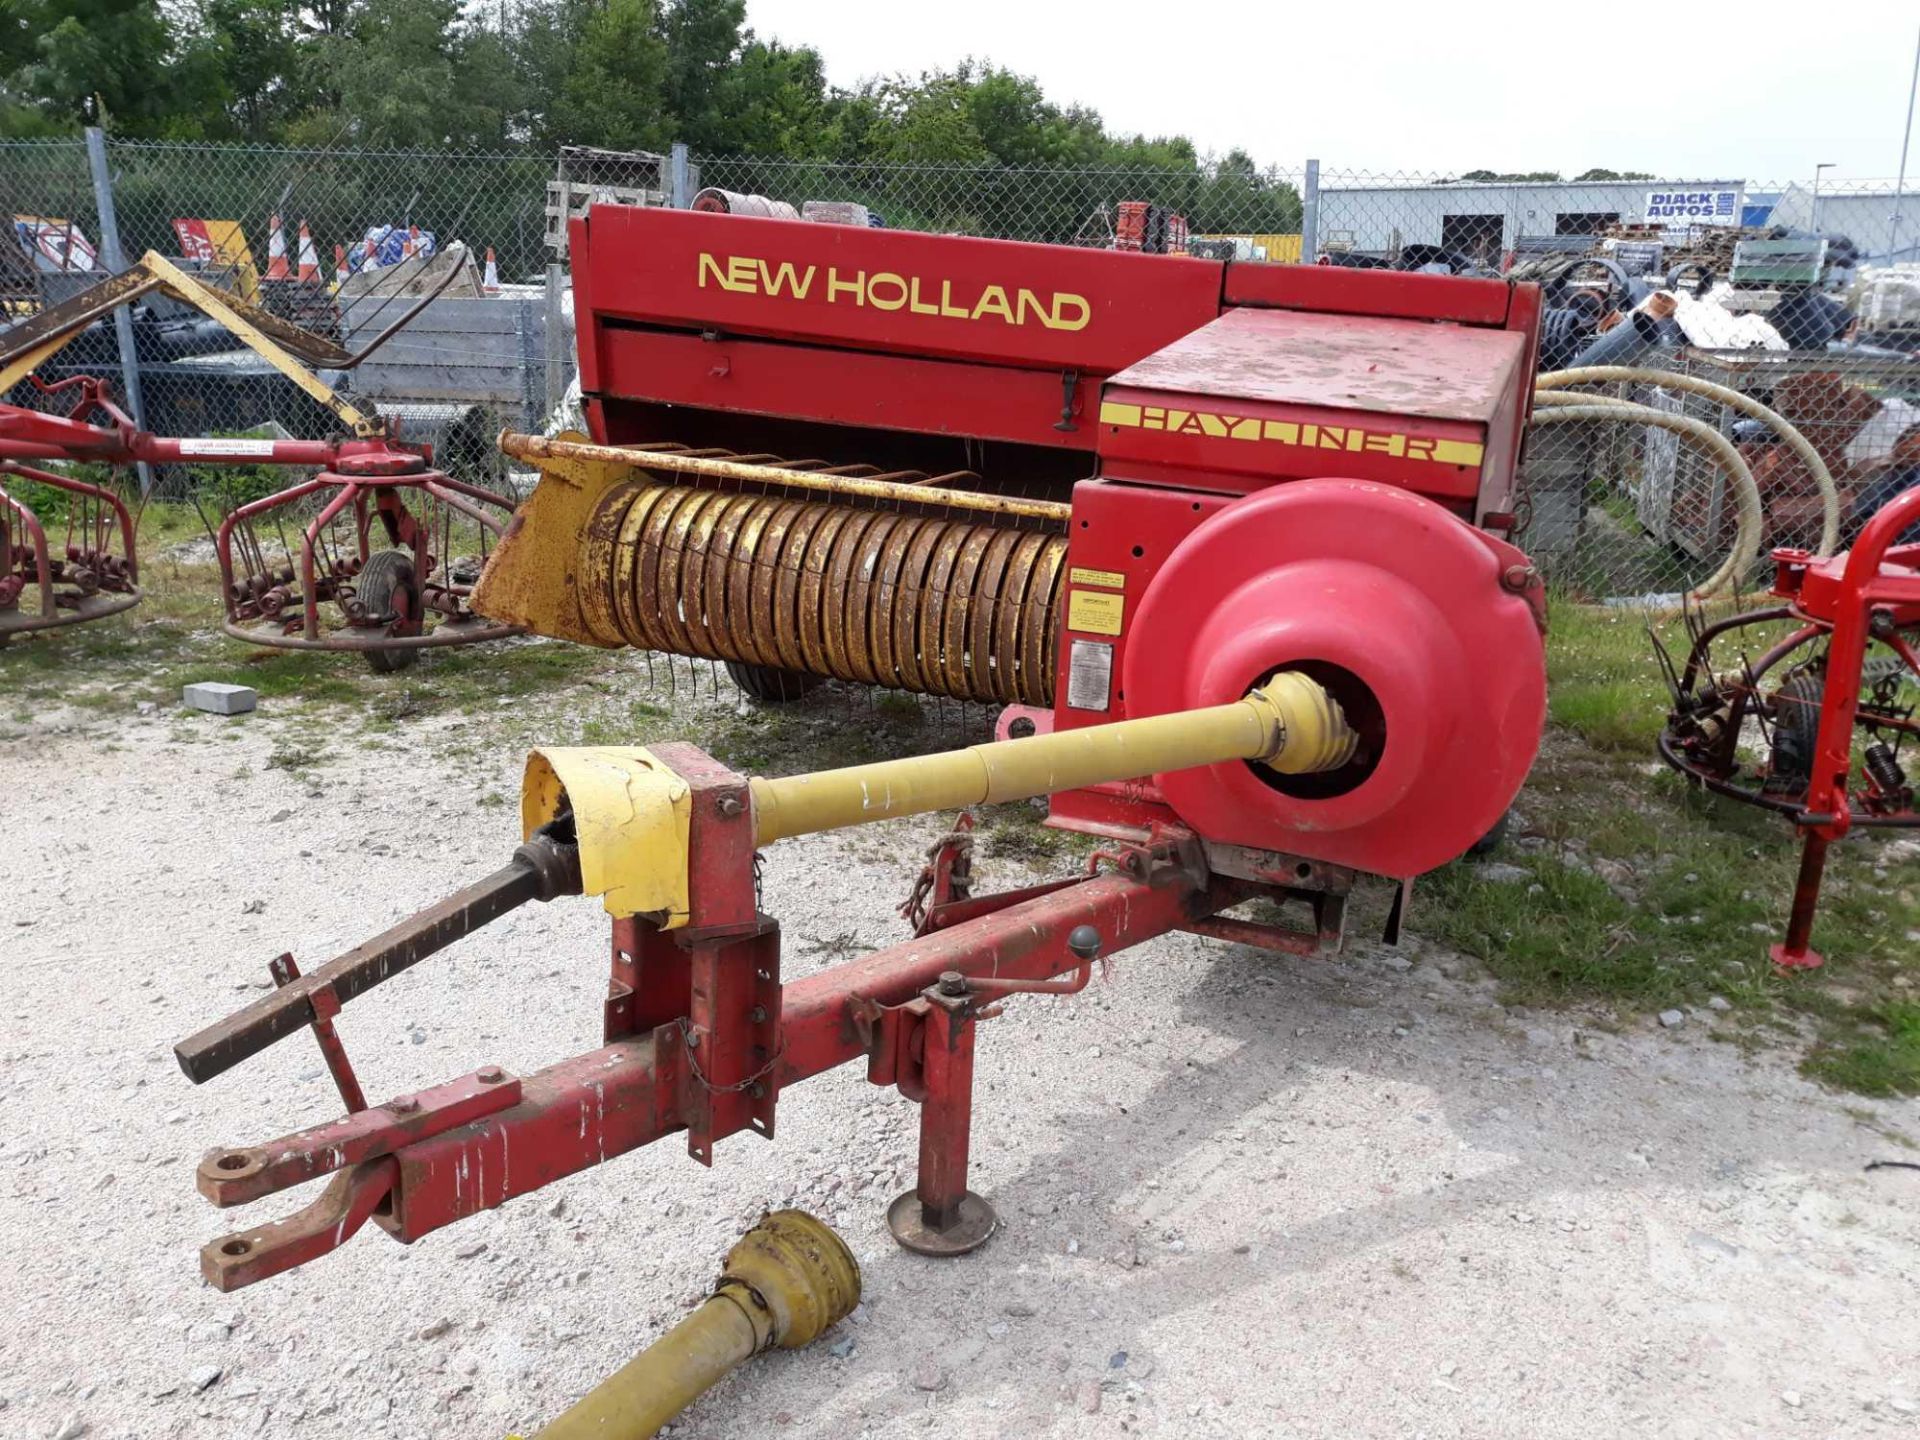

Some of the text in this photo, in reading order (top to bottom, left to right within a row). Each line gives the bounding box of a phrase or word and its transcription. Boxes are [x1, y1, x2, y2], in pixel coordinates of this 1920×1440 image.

[1647, 205, 1714, 217] AUTOS
[1651, 193, 1713, 205] DIACK
[177, 223, 195, 251] SITE
[698, 253, 1091, 331] NEW HOLLAND
[1140, 405, 1438, 461] HAYLINER
